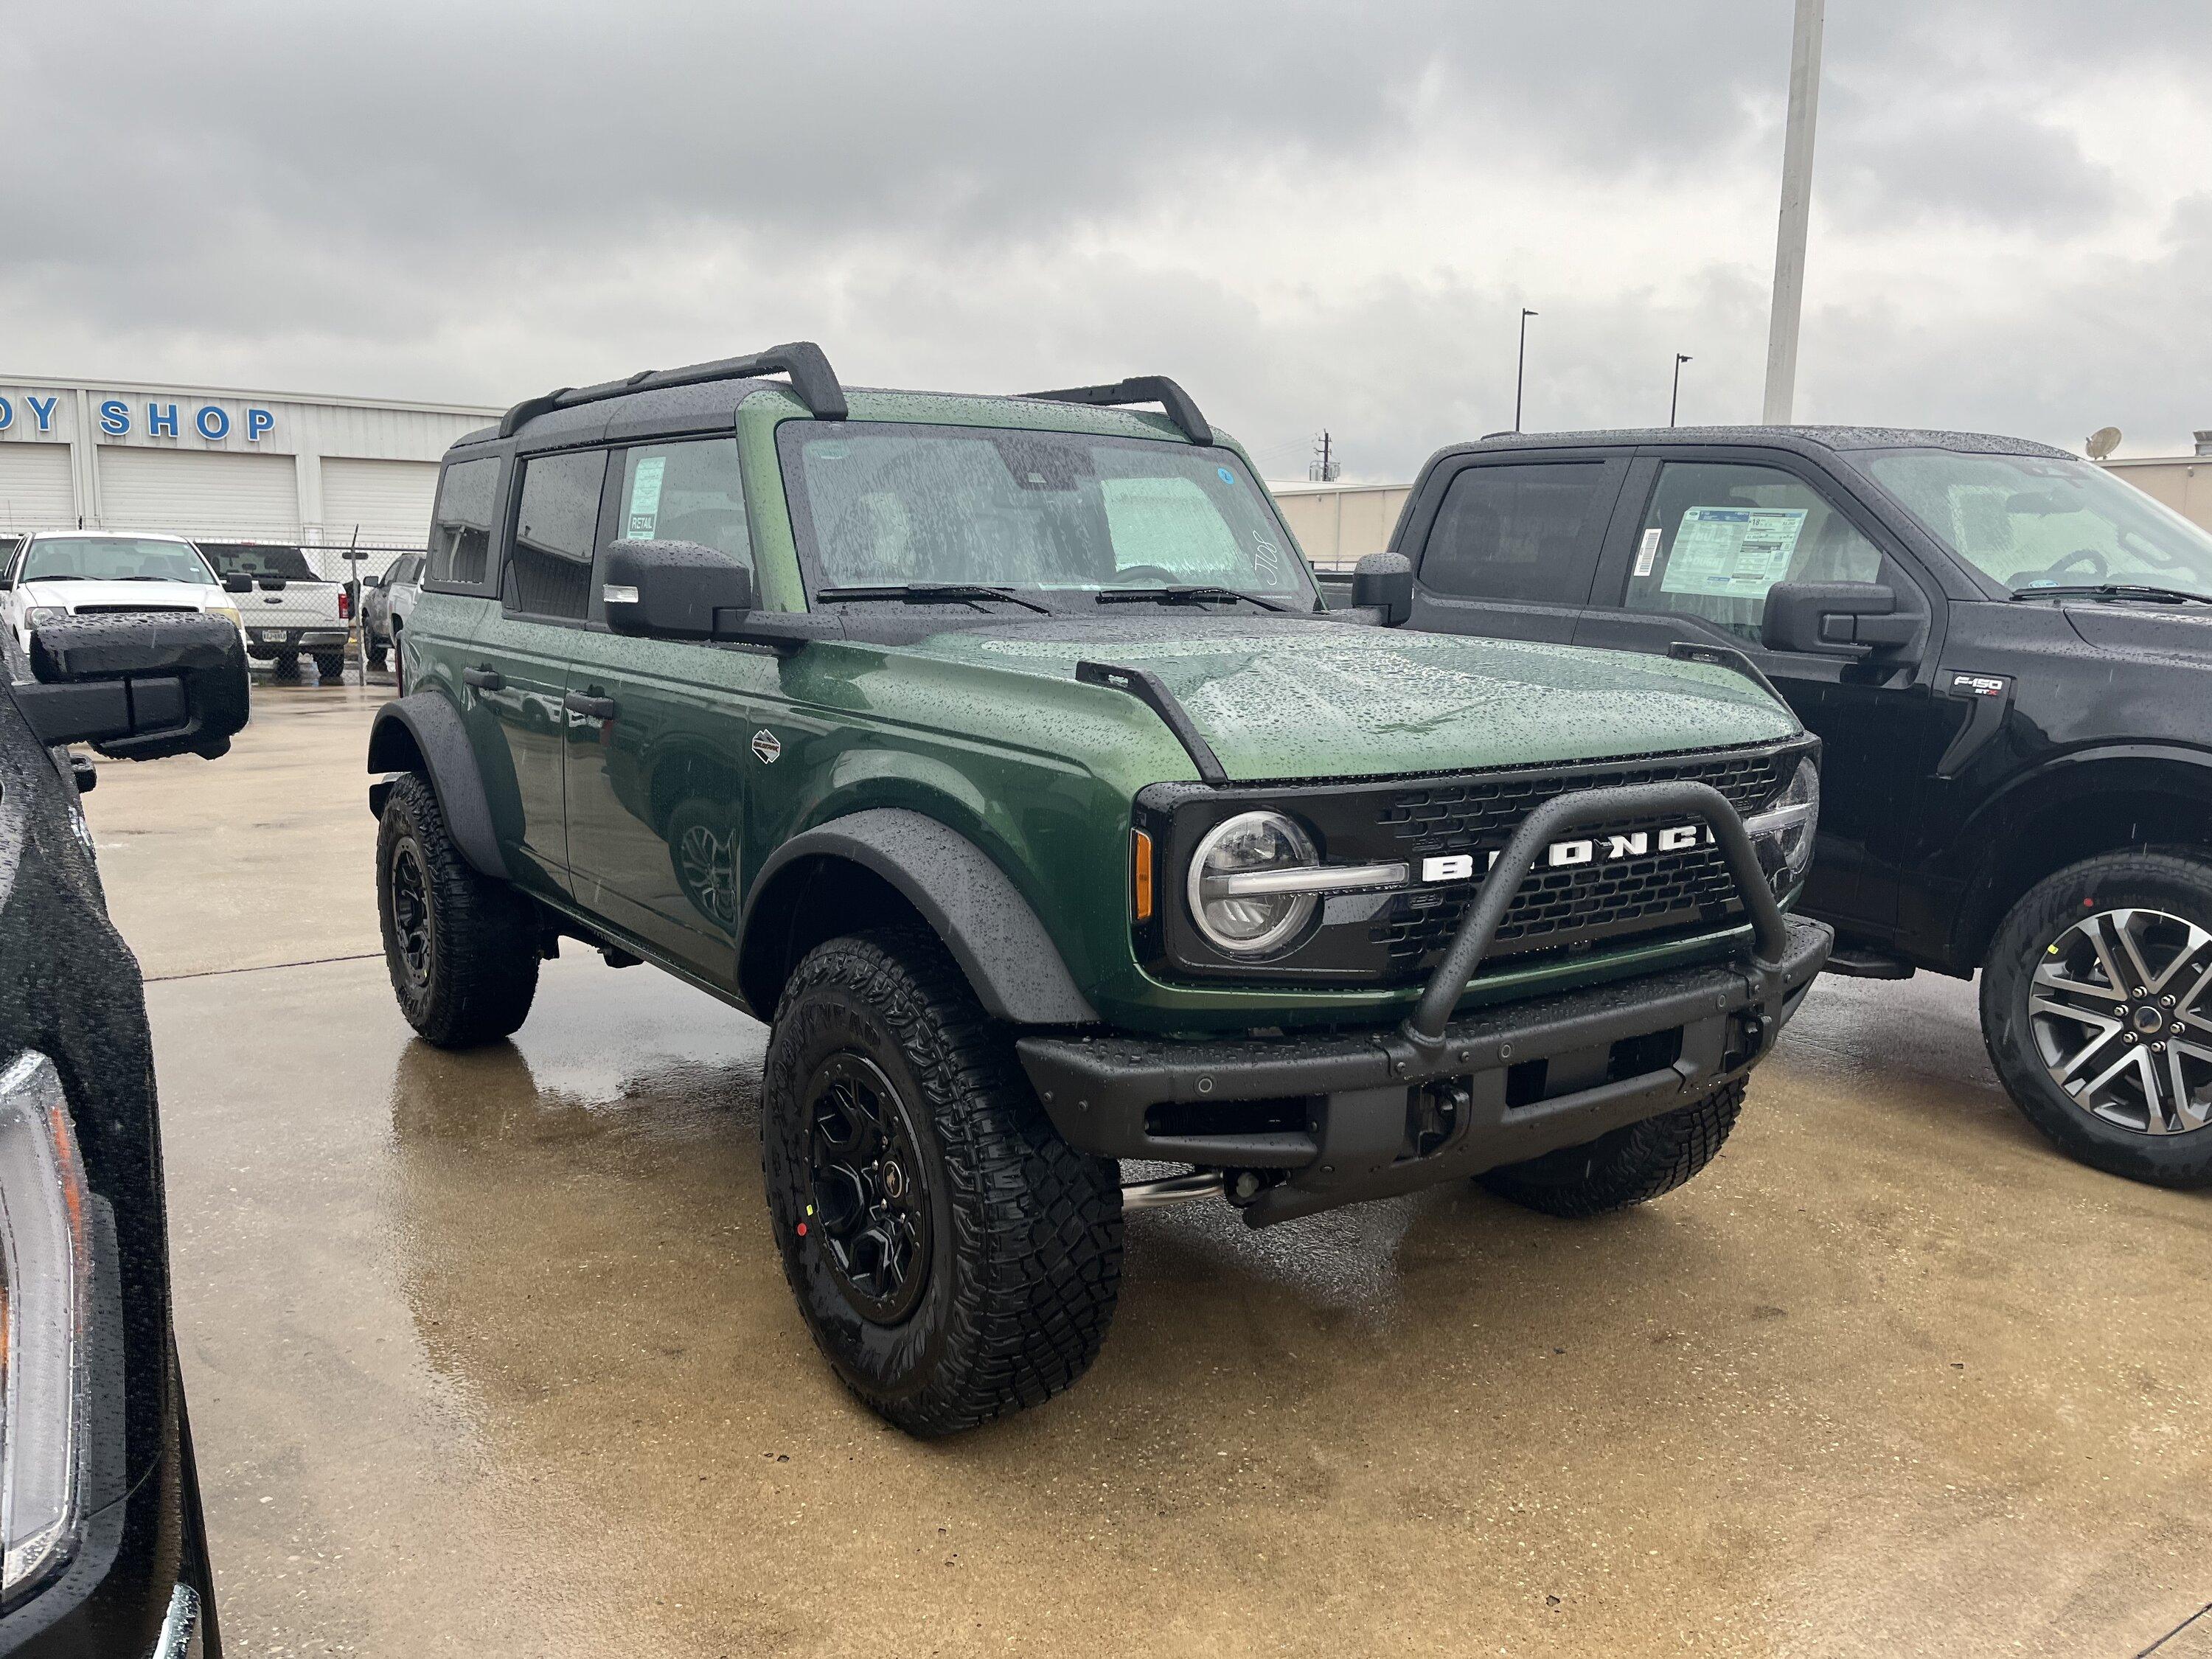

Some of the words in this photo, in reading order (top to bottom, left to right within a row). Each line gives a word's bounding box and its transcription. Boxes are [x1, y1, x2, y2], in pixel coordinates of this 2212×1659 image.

[100, 400, 275, 442] SHOP
[632, 517, 653, 529] RETAIL
[1954, 676, 2003, 690] F-150
[1975, 688, 2000, 696] STX
[1422, 826, 1715, 882] BONC
